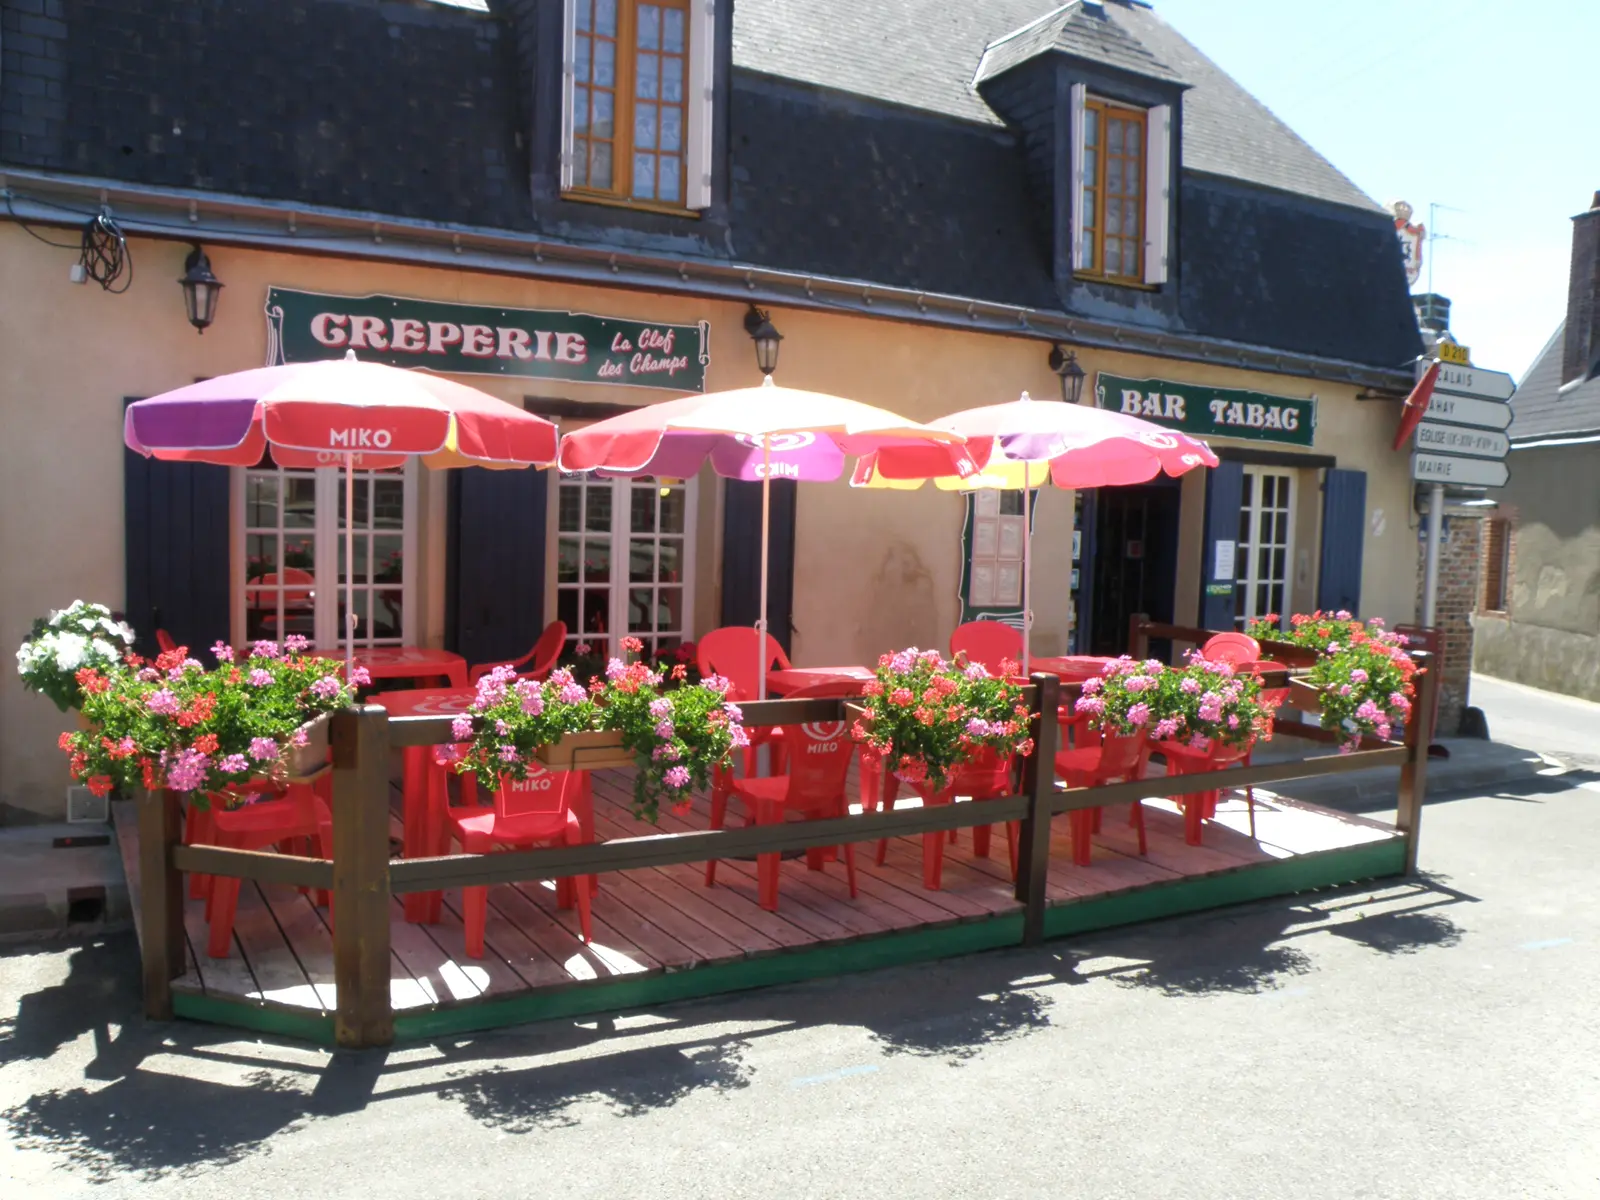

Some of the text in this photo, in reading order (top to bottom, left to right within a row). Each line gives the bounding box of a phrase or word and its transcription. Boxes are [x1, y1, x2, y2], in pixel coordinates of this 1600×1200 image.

[310, 312, 588, 364] CREPERIE
[611, 327, 675, 355] La Clef
[597, 351, 689, 378] des Champs
[1120, 388, 1300, 431] BAR TABAC
[1428, 399, 1456, 414] AHAY
[329, 427, 392, 449] MIKO
[1418, 459, 1452, 476] MAIRIE
[807, 742, 838, 754] MIKO
[511, 778, 551, 793] MIKO
